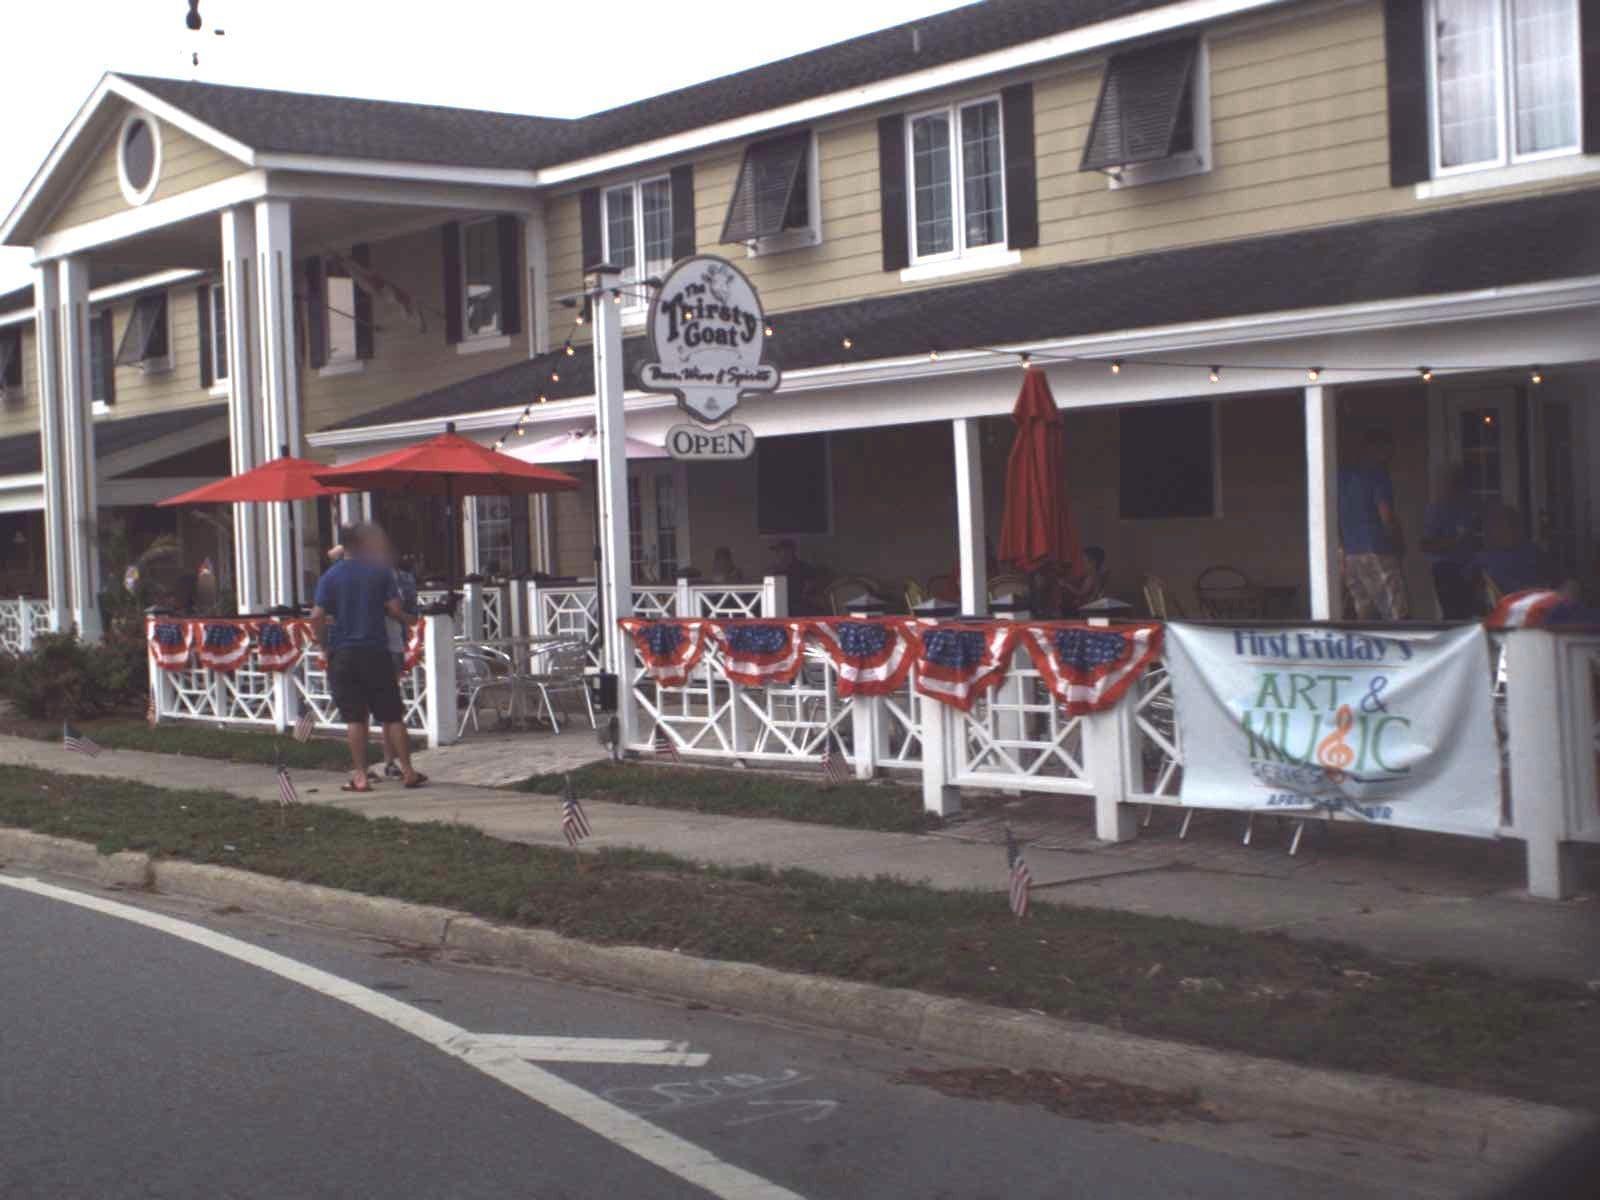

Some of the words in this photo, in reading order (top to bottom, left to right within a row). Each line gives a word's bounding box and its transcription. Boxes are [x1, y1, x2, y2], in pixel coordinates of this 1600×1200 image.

[685, 282, 706, 298] The
[661, 292, 757, 343] Thirsty
[683, 321, 739, 348] Goat
[673, 430, 747, 455] OPEN
[1233, 630, 1290, 658] First
[1255, 672, 1352, 711] ART
[1360, 675, 1389, 713] &
